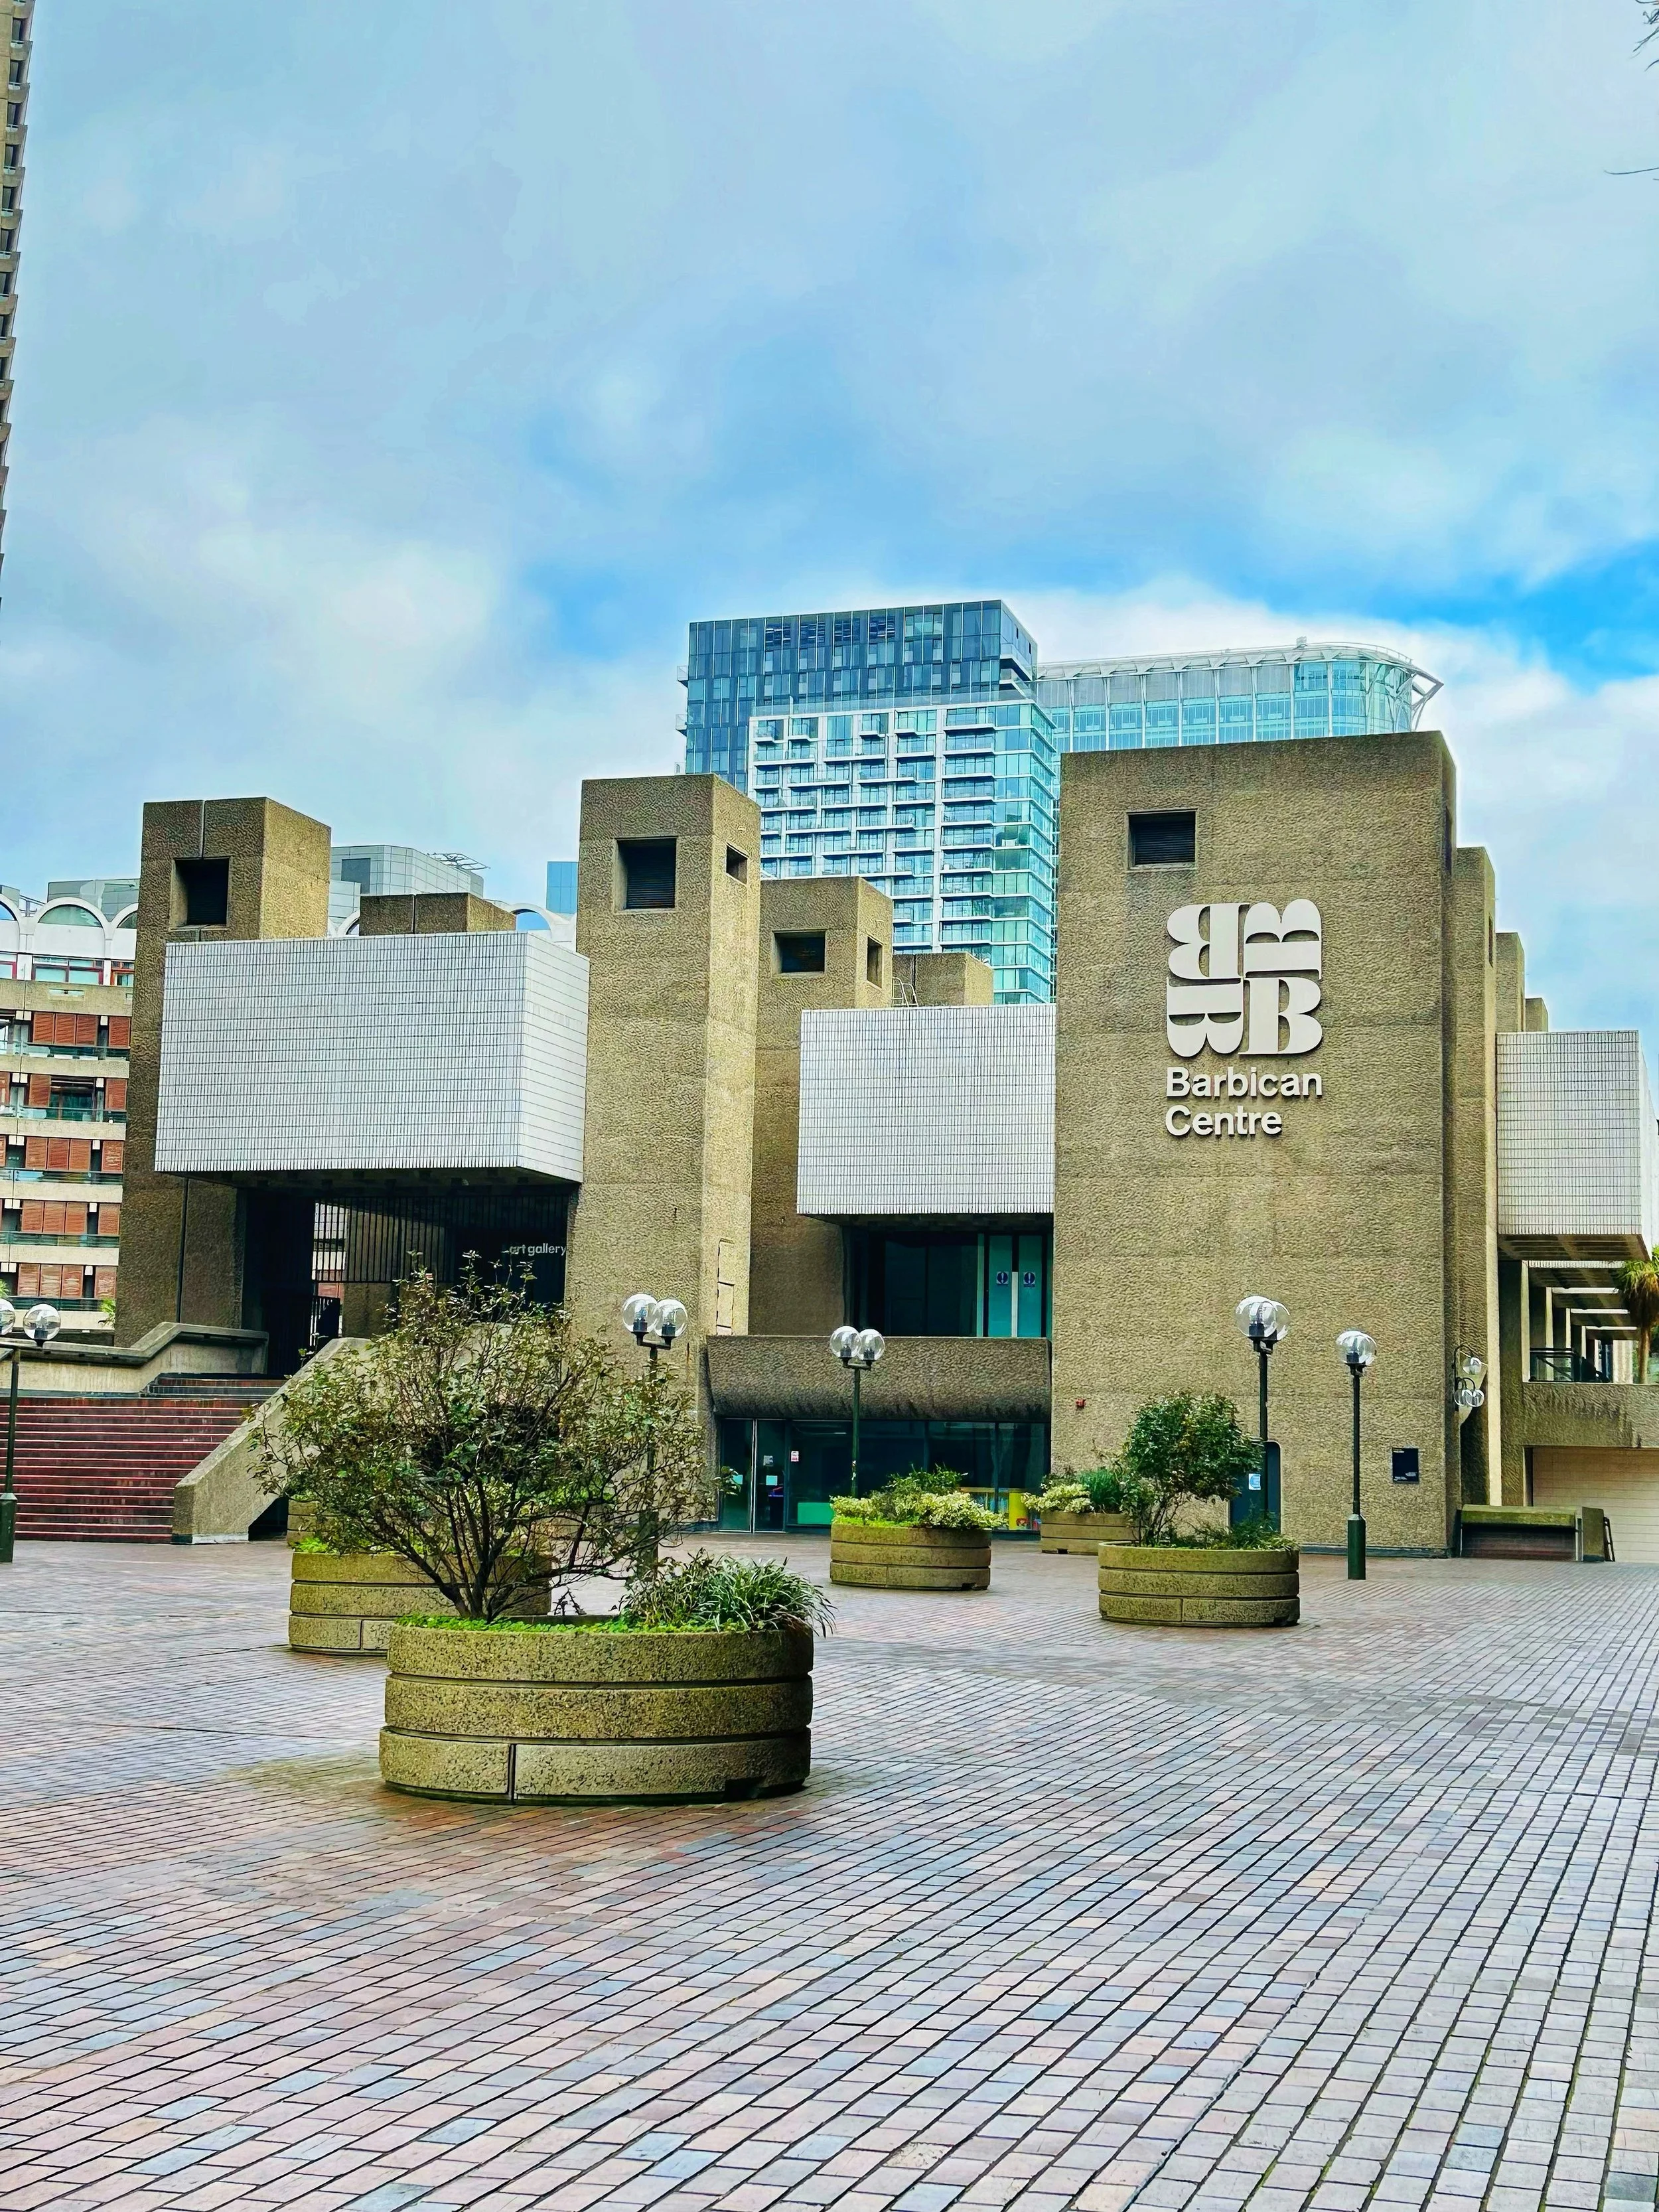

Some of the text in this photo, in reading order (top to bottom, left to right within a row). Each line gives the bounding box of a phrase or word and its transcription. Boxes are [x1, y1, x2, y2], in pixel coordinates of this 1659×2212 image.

[1166, 1066, 1323, 1097] Barbican
[1165, 1104, 1282, 1137] Centre
[509, 1242, 567, 1256] art gallery
